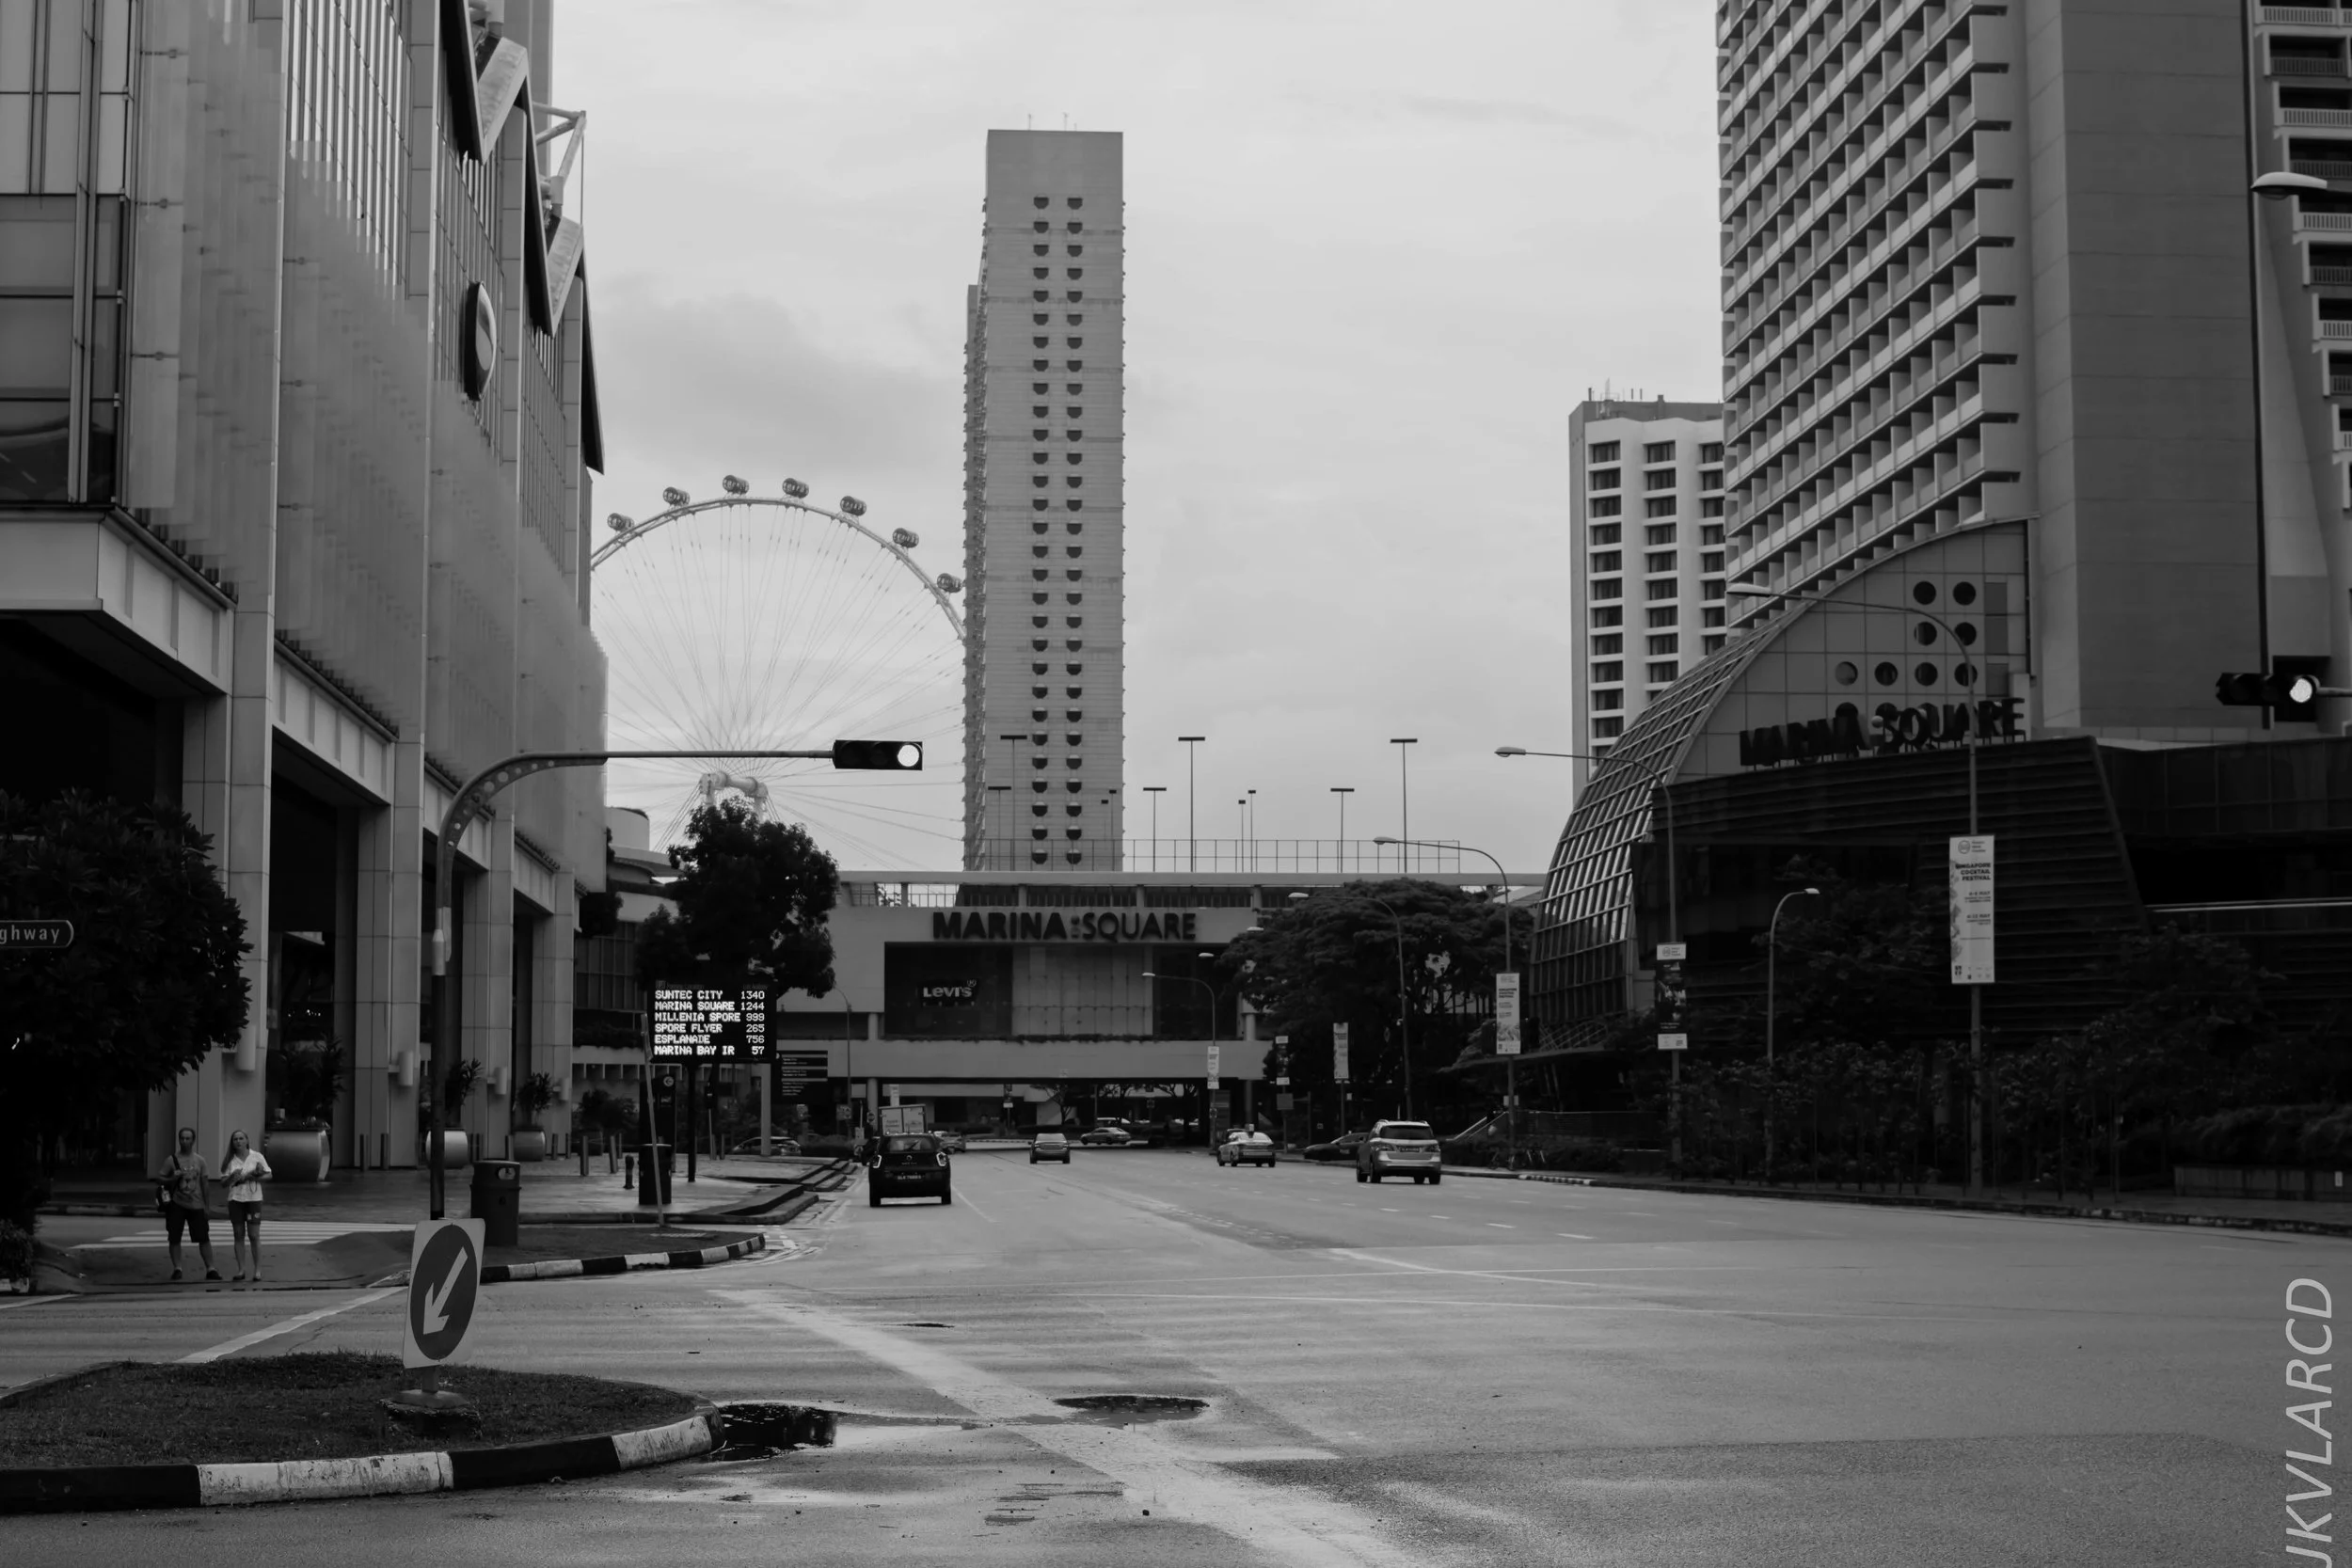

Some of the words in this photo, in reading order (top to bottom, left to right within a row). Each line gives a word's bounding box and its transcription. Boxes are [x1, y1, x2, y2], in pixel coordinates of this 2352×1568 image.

[1878, 697, 2026, 755] SQUARE
[932, 911, 1068, 942] MARINA
[1082, 911, 1197, 943] SQUARE
[0, 925, 60, 945] ghway
[655, 990, 693, 1000] SUNTEC
[696, 990, 723, 1000] CITY
[740, 990, 765, 1000] 1340
[922, 986, 973, 998] Levi's
[654, 1001, 693, 1011] MARINA
[696, 1001, 736, 1011] SQUARE
[740, 1001, 765, 1011] 1244
[708, 1011, 741, 1022] SPORE
[745, 1012, 765, 1022] 999
[654, 1022, 687, 1033] SPORE
[691, 1022, 723, 1033] FLYER
[745, 1023, 765, 1033] 265
[654, 1034, 711, 1044] ESPLANADE
[745, 1035, 765, 1044] 756
[653, 1045, 693, 1055] MARINA
[696, 1045, 717, 1055] BAY
[722, 1045, 736, 1055] IR
[751, 1046, 765, 1055] 57
